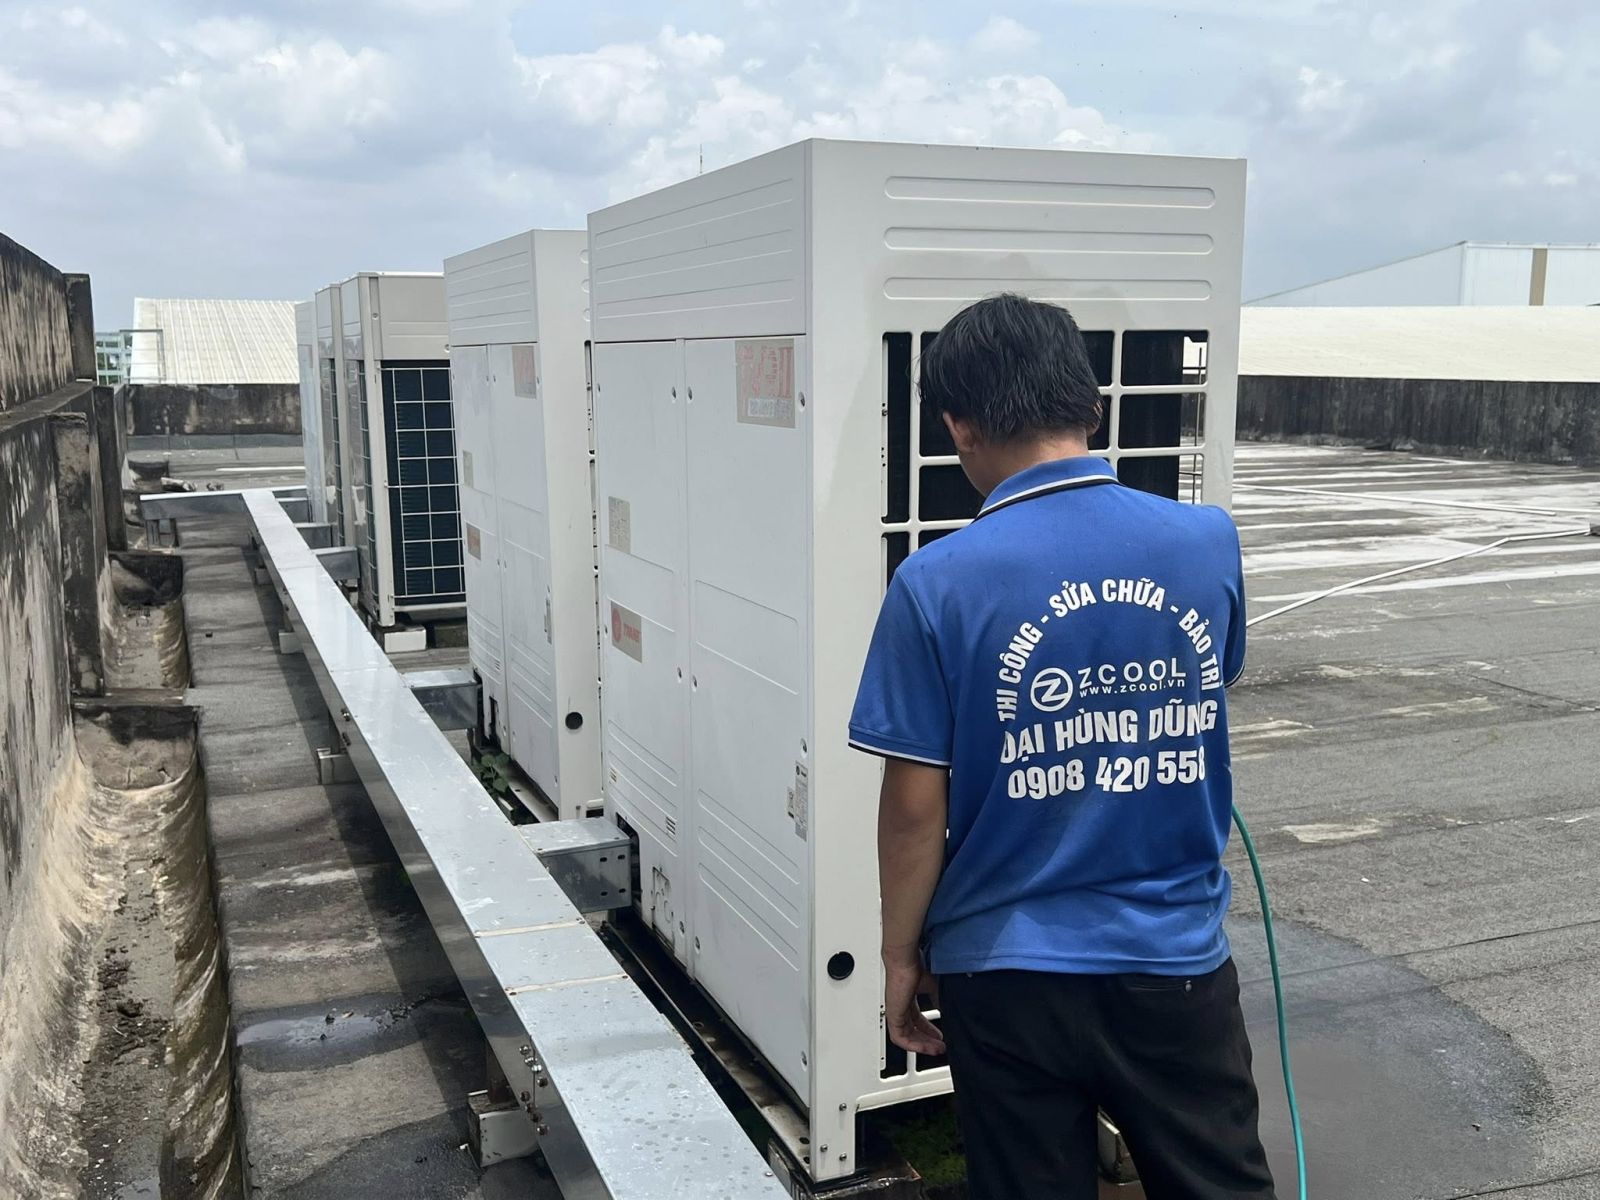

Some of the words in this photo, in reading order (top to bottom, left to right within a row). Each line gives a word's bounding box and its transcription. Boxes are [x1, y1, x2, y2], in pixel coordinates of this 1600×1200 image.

[1049, 580, 1097, 618] SỬA
[1102, 577, 1166, 612] CHỮA
[1179, 608, 1210, 654] BẢO
[999, 622, 1043, 684] CÔNG
[1078, 657, 1186, 689] ZCOOL
[1080, 678, 1185, 698] www.zcool.vn
[997, 689, 1018, 721] THI
[1149, 698, 1218, 741] DŨNG
[1008, 759, 1085, 800] 0908
[1096, 756, 1150, 792] 420
